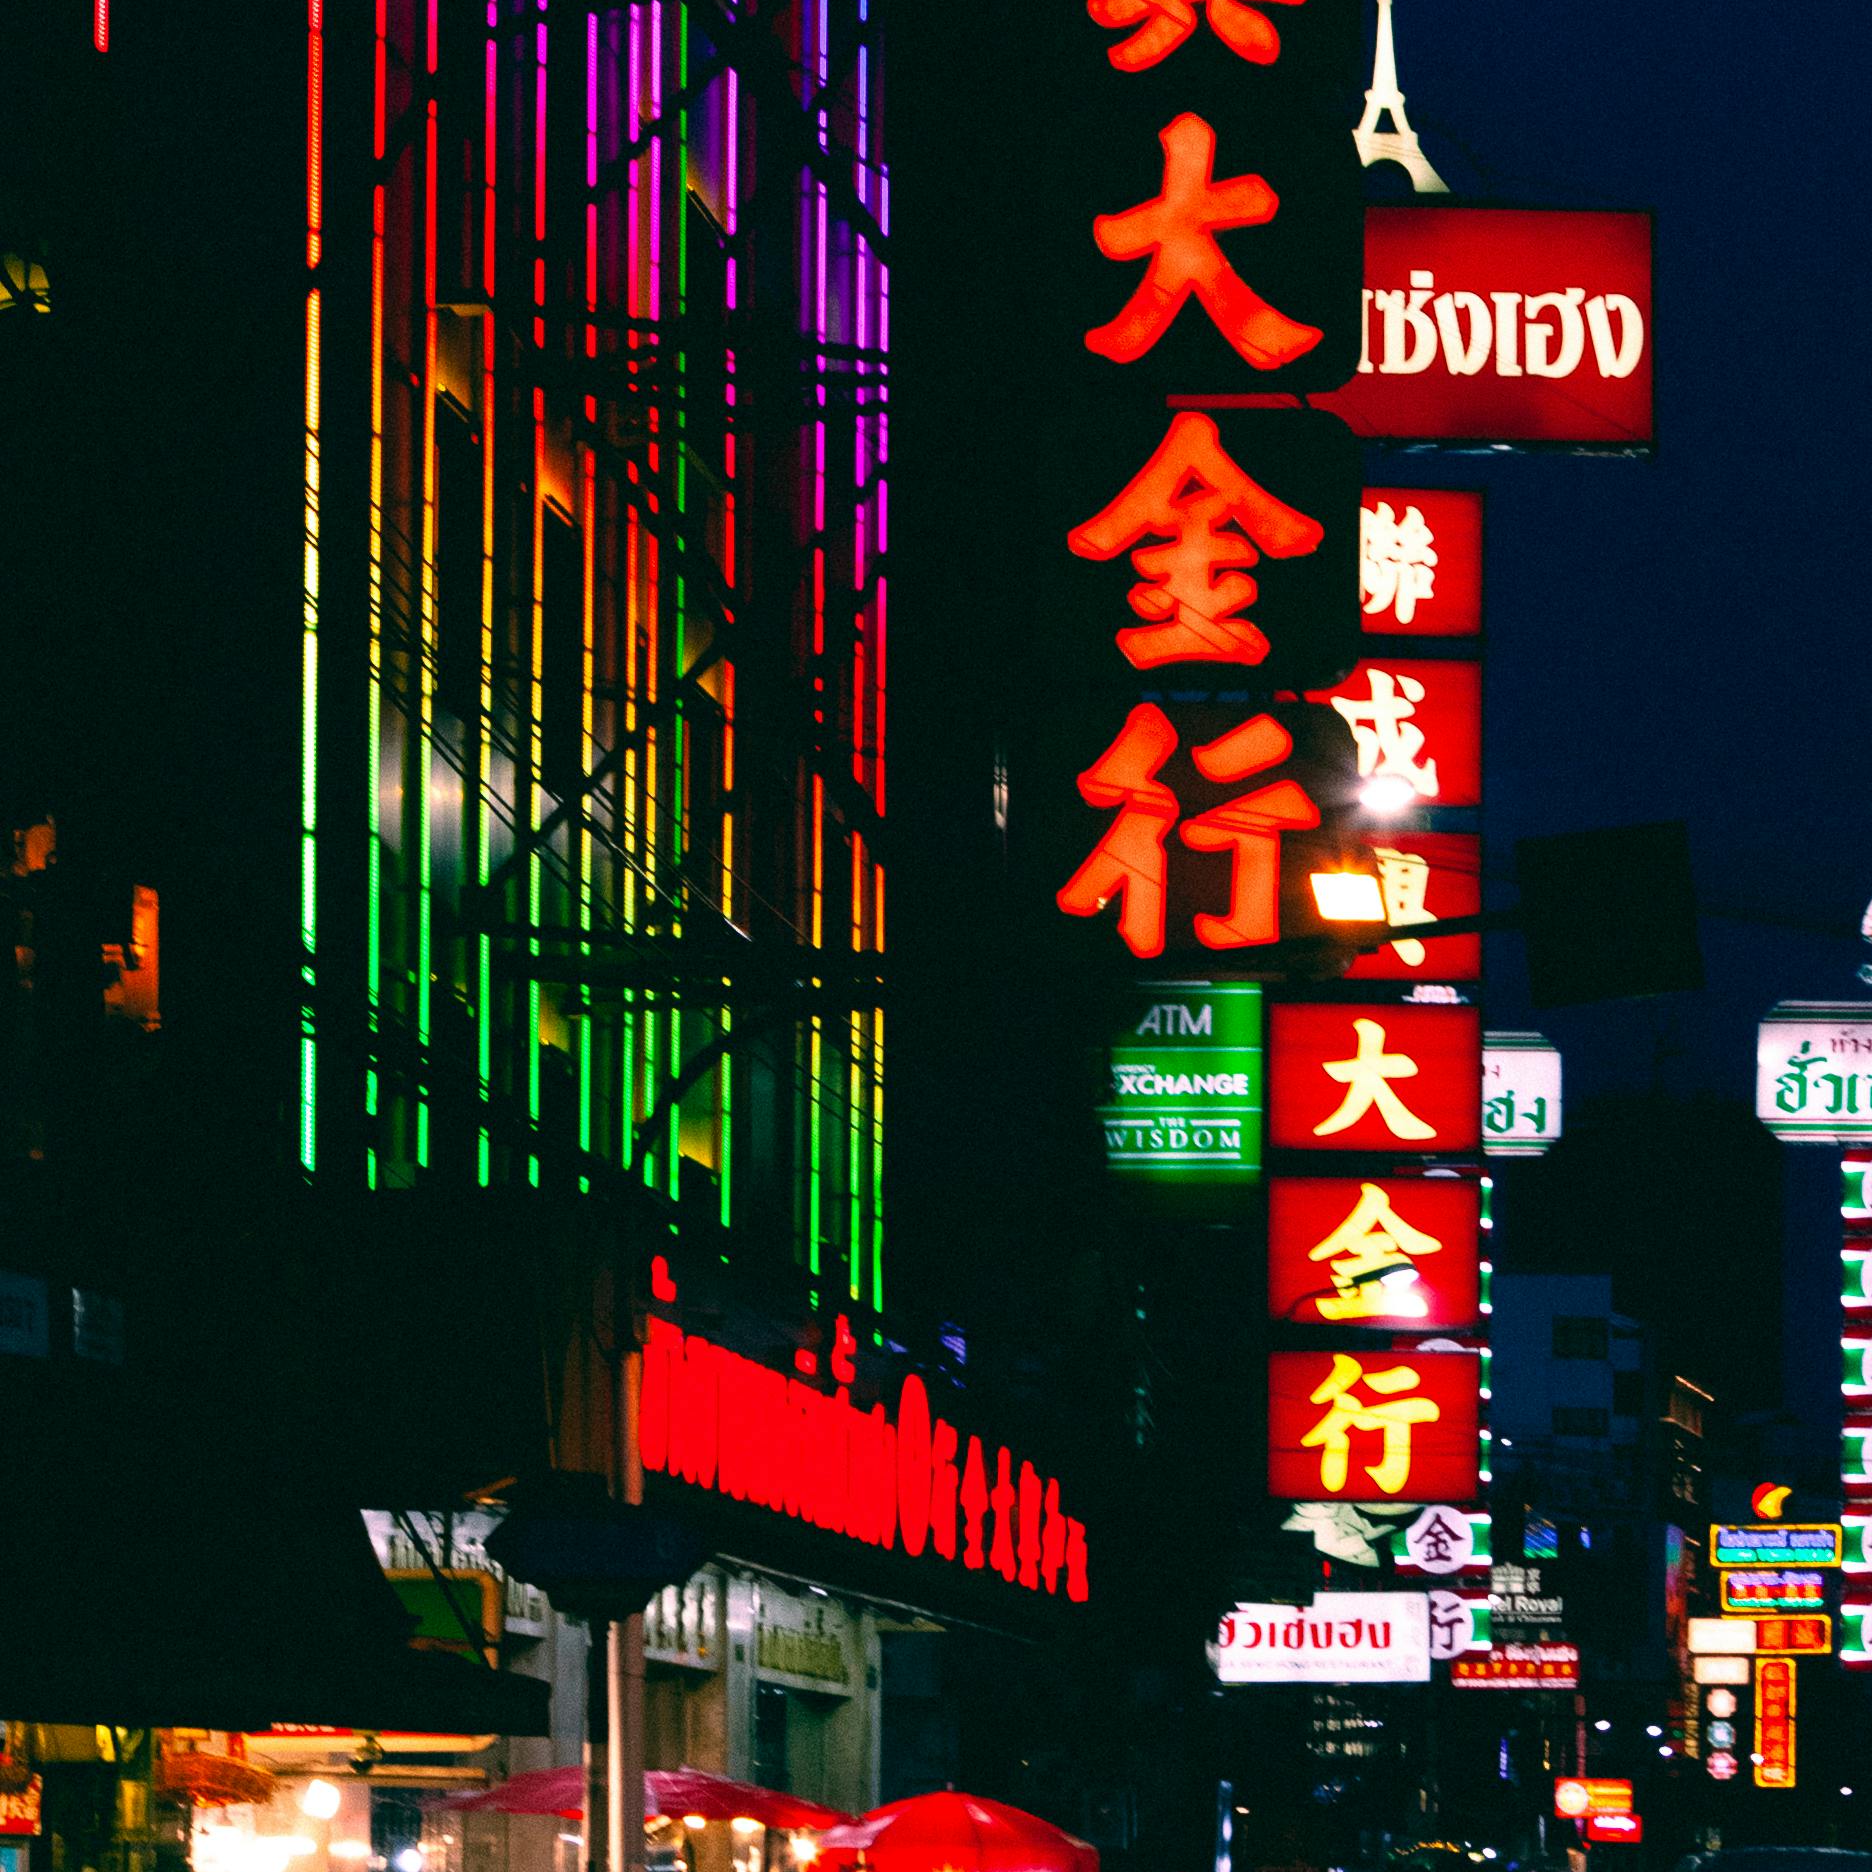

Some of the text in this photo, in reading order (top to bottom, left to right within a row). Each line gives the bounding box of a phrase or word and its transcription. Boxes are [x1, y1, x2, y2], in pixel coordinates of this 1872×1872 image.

[1137, 1004, 1212, 1036] ATM
[1118, 1073, 1249, 1095] XCHANGE
[1158, 1117, 1186, 1129] THE
[1104, 1129, 1241, 1149] WISDOM
